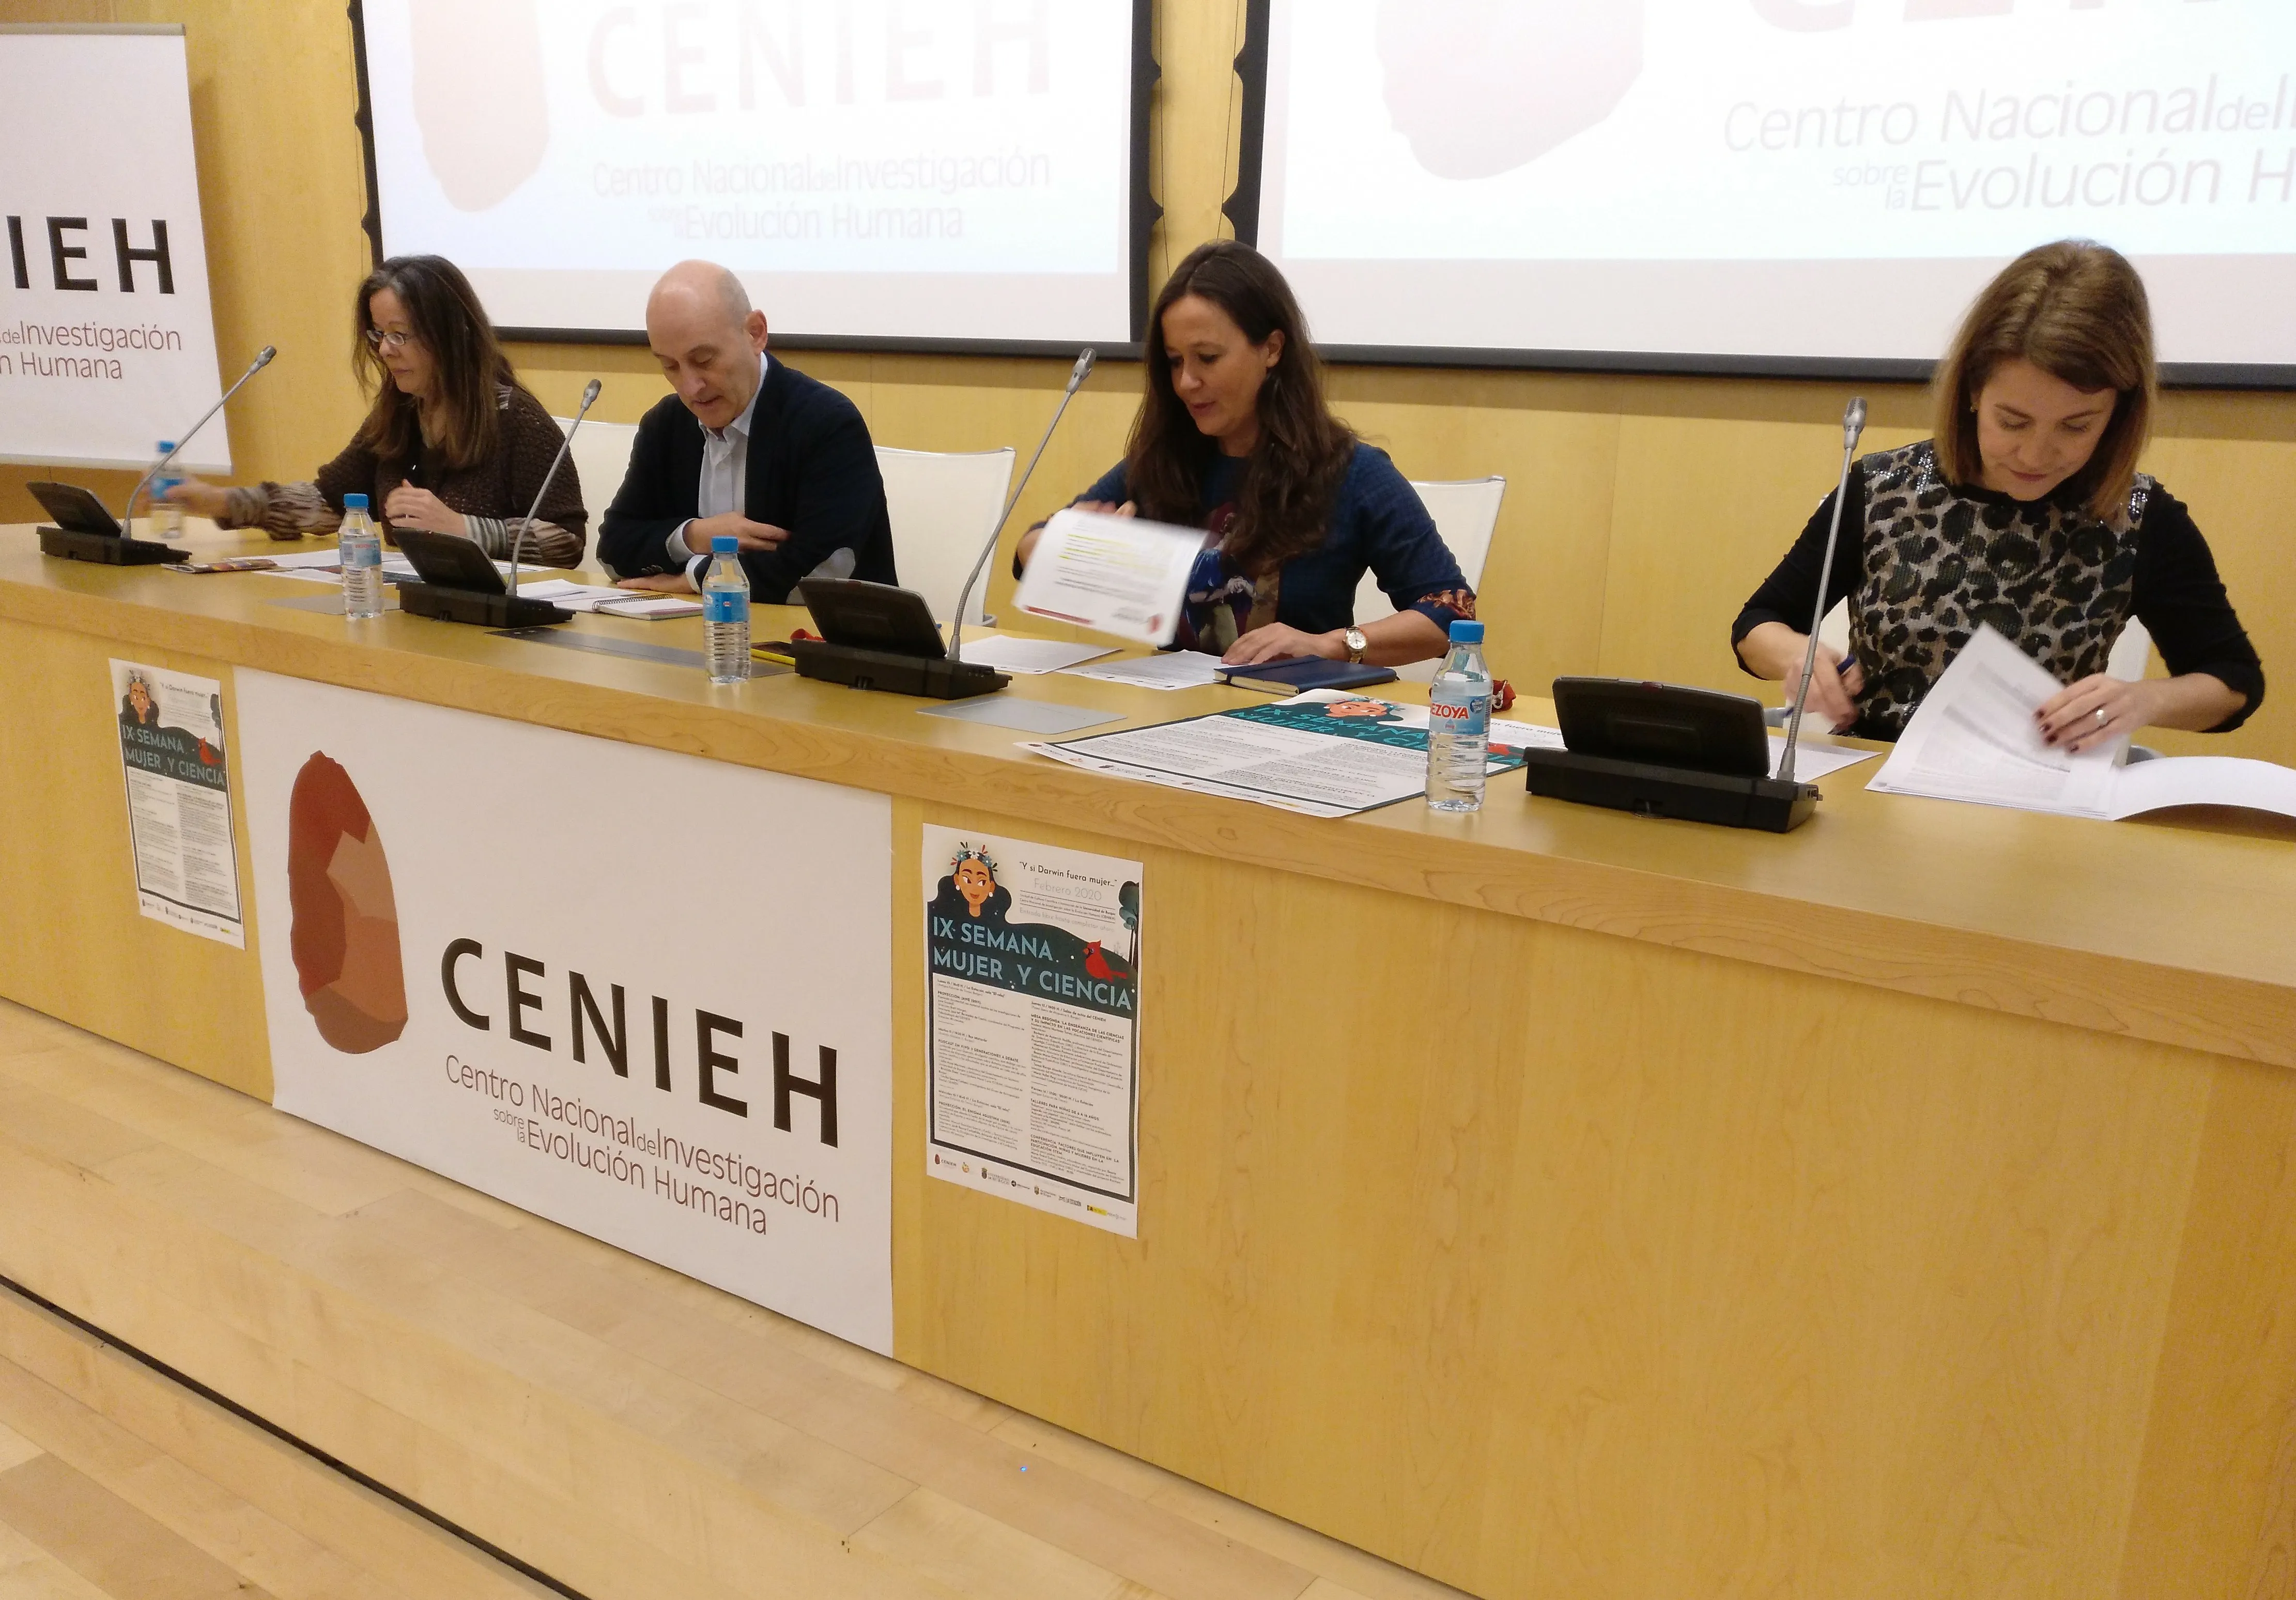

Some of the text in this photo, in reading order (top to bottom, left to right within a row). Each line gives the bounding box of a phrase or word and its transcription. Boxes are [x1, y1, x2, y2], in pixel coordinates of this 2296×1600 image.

[587, 0, 1050, 118] CENIEH
[1723, 96, 1918, 152] Centro
[1940, 73, 2217, 143] Nacional
[593, 162, 683, 197] Centro
[692, 152, 811, 195] Nacional
[837, 145, 1050, 195] Investigación
[1833, 159, 1909, 187] sobre
[1911, 148, 2222, 212] Evolución
[685, 201, 822, 240] Evolución
[831, 204, 963, 239] Humana
[20, 320, 182, 352] Investigación
[20, 352, 123, 379] Humana
[122, 725, 184, 753] IX SEMANA
[124, 747, 225, 786] MUJER Y CIENCIA
[1035, 878, 1102, 901] Febrero 2020
[1038, 865, 1064, 878] Darwin
[1066, 870, 1087, 881] fuera
[1020, 907, 1040, 917] Entrada
[933, 916, 1054, 961] IX SEMANA
[933, 946, 1003, 980] MUJER
[1016, 963, 1033, 986] Y
[1039, 970, 1132, 1010] CIENCIA
[441, 938, 838, 1148] CENIEH
[1072, 1028, 1096, 1037] VOCACIONES
[493, 1106, 525, 1130] sobre
[1031, 1098, 1048, 1106] TALLERES
[445, 1054, 524, 1107] Centro
[532, 1084, 635, 1148] Nacional
[656, 1128, 839, 1222] Investigación
[1086, 1150, 1105, 1159] INFLUYEN
[517, 1119, 767, 1235] la Evolución Humana
